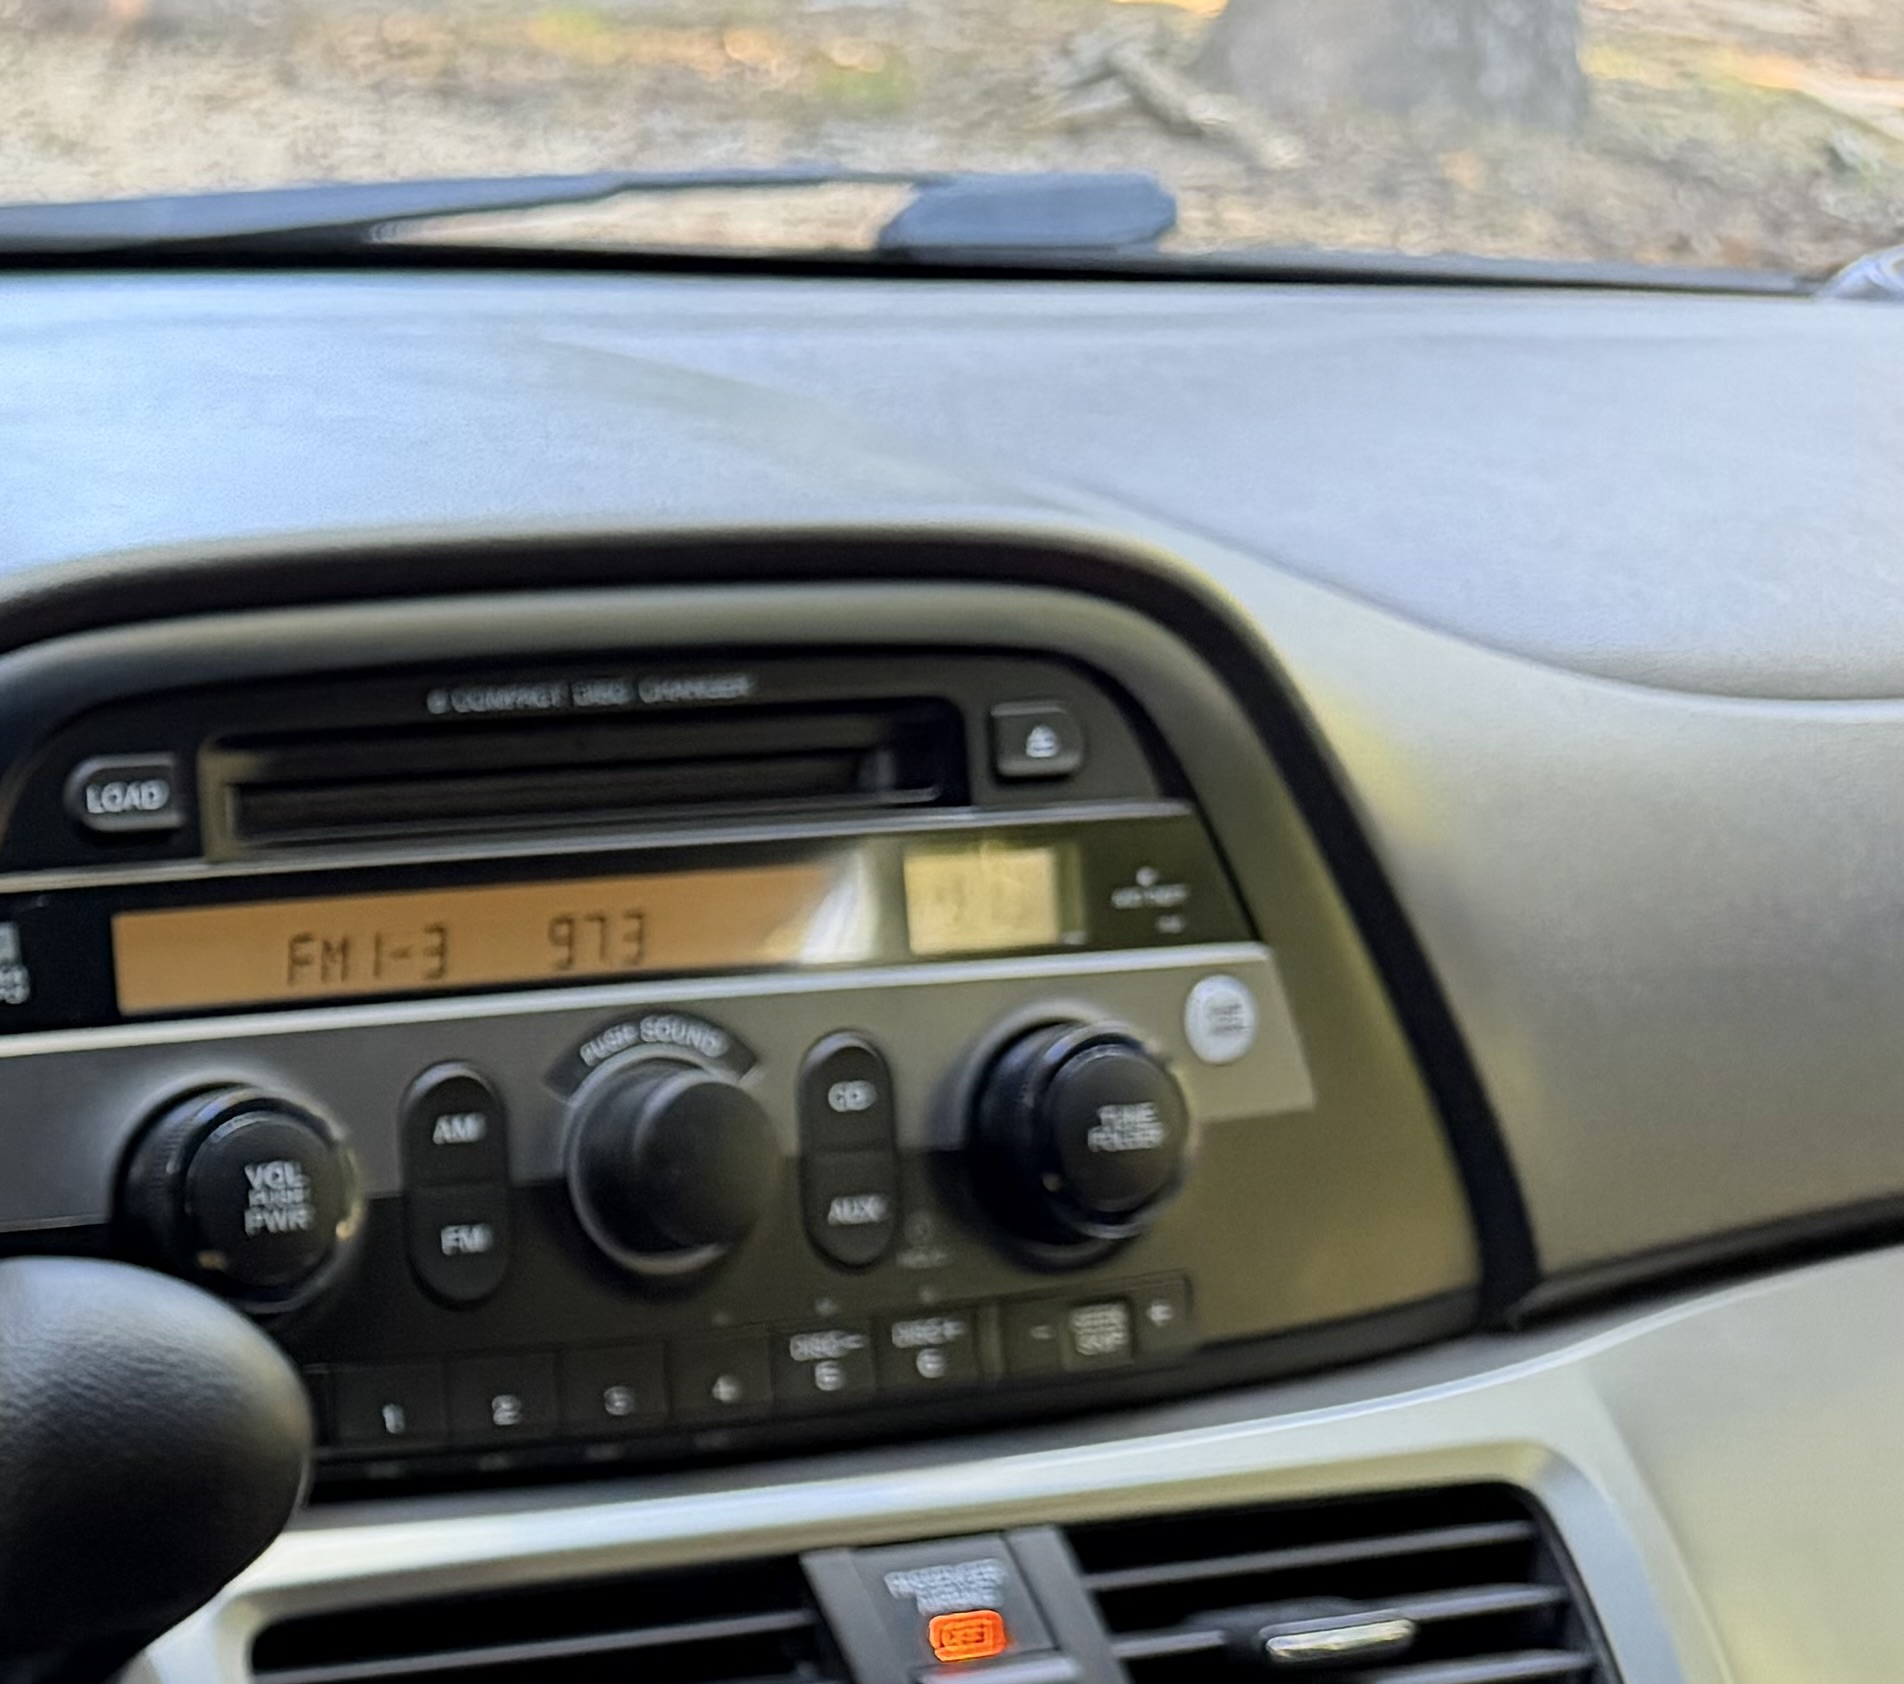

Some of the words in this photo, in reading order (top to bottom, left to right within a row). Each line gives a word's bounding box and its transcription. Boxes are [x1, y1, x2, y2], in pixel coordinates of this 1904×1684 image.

[85, 778, 171, 814] LOAD
[640, 1014, 731, 1057] SOUND
[432, 1112, 486, 1144] AM
[244, 1161, 311, 1190] VOL
[244, 1205, 315, 1236] PWR
[827, 1195, 889, 1225] AUX
[440, 1223, 492, 1257] FM
